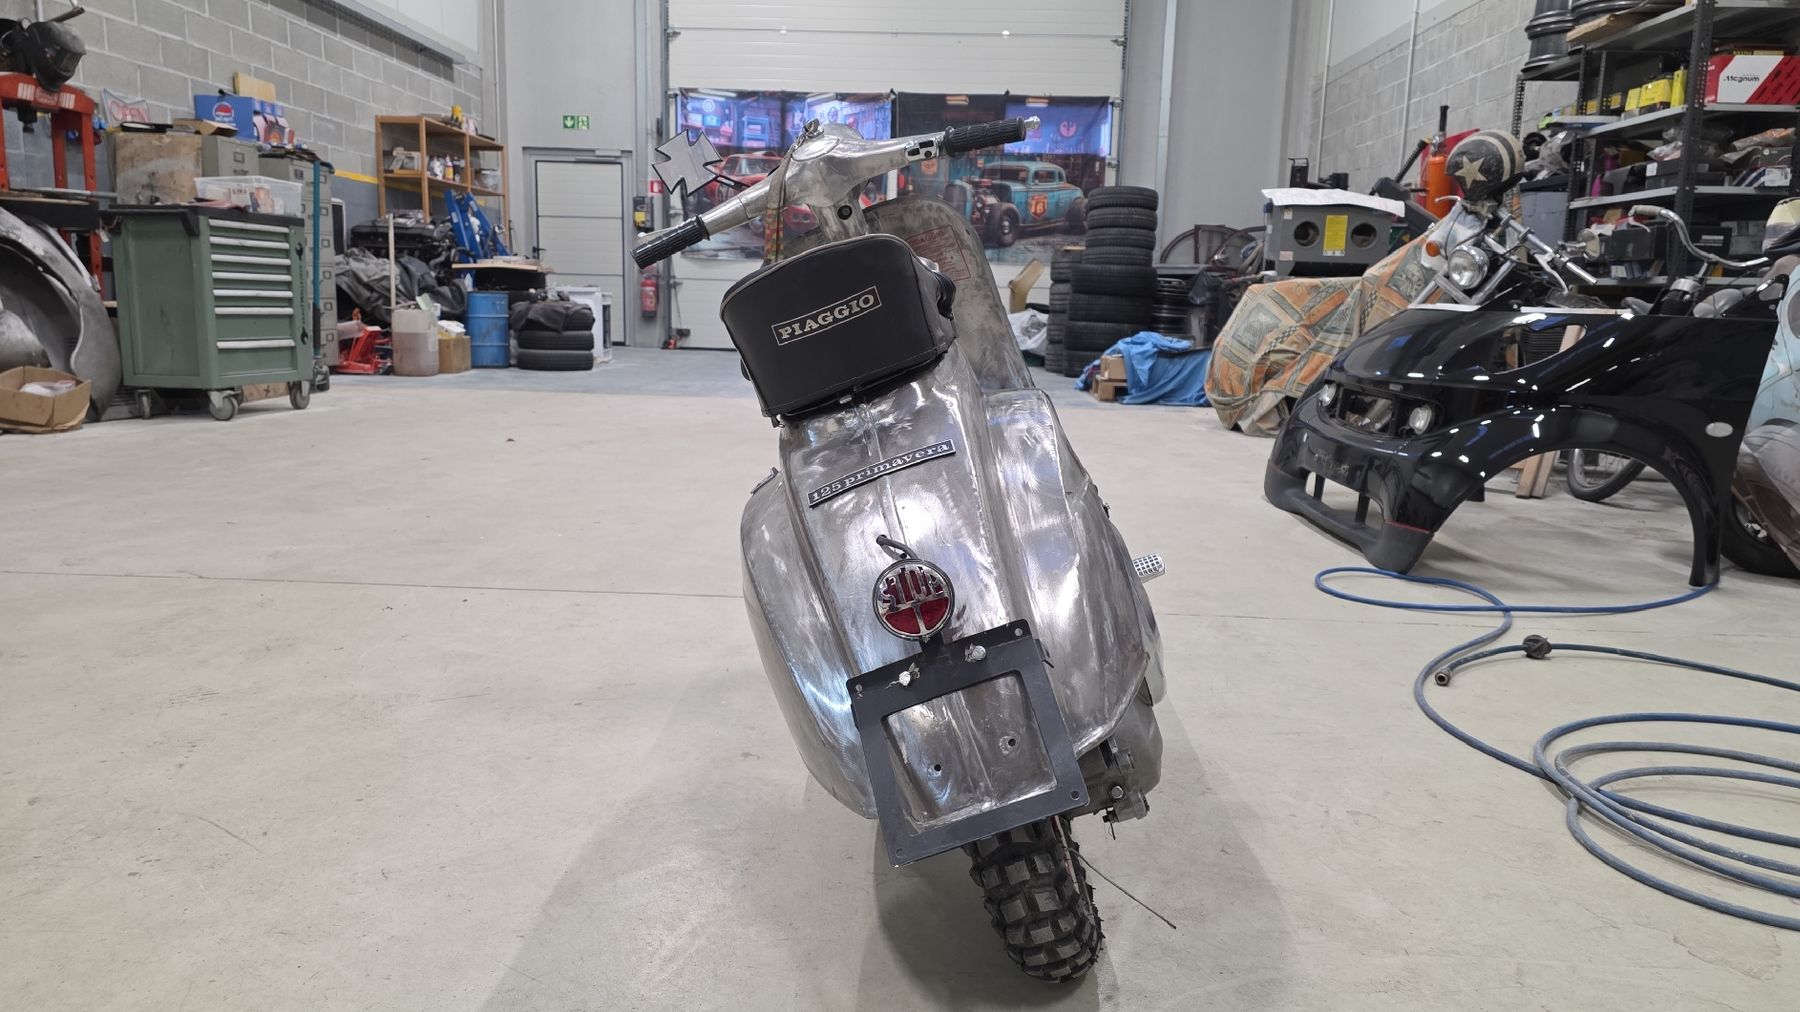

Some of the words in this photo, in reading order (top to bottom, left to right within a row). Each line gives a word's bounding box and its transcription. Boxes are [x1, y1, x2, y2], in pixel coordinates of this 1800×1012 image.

[778, 294, 875, 339] PIAGGIO
[811, 481, 842, 501] 125
[843, 443, 950, 488] primavera
[879, 565, 945, 611] STOP
